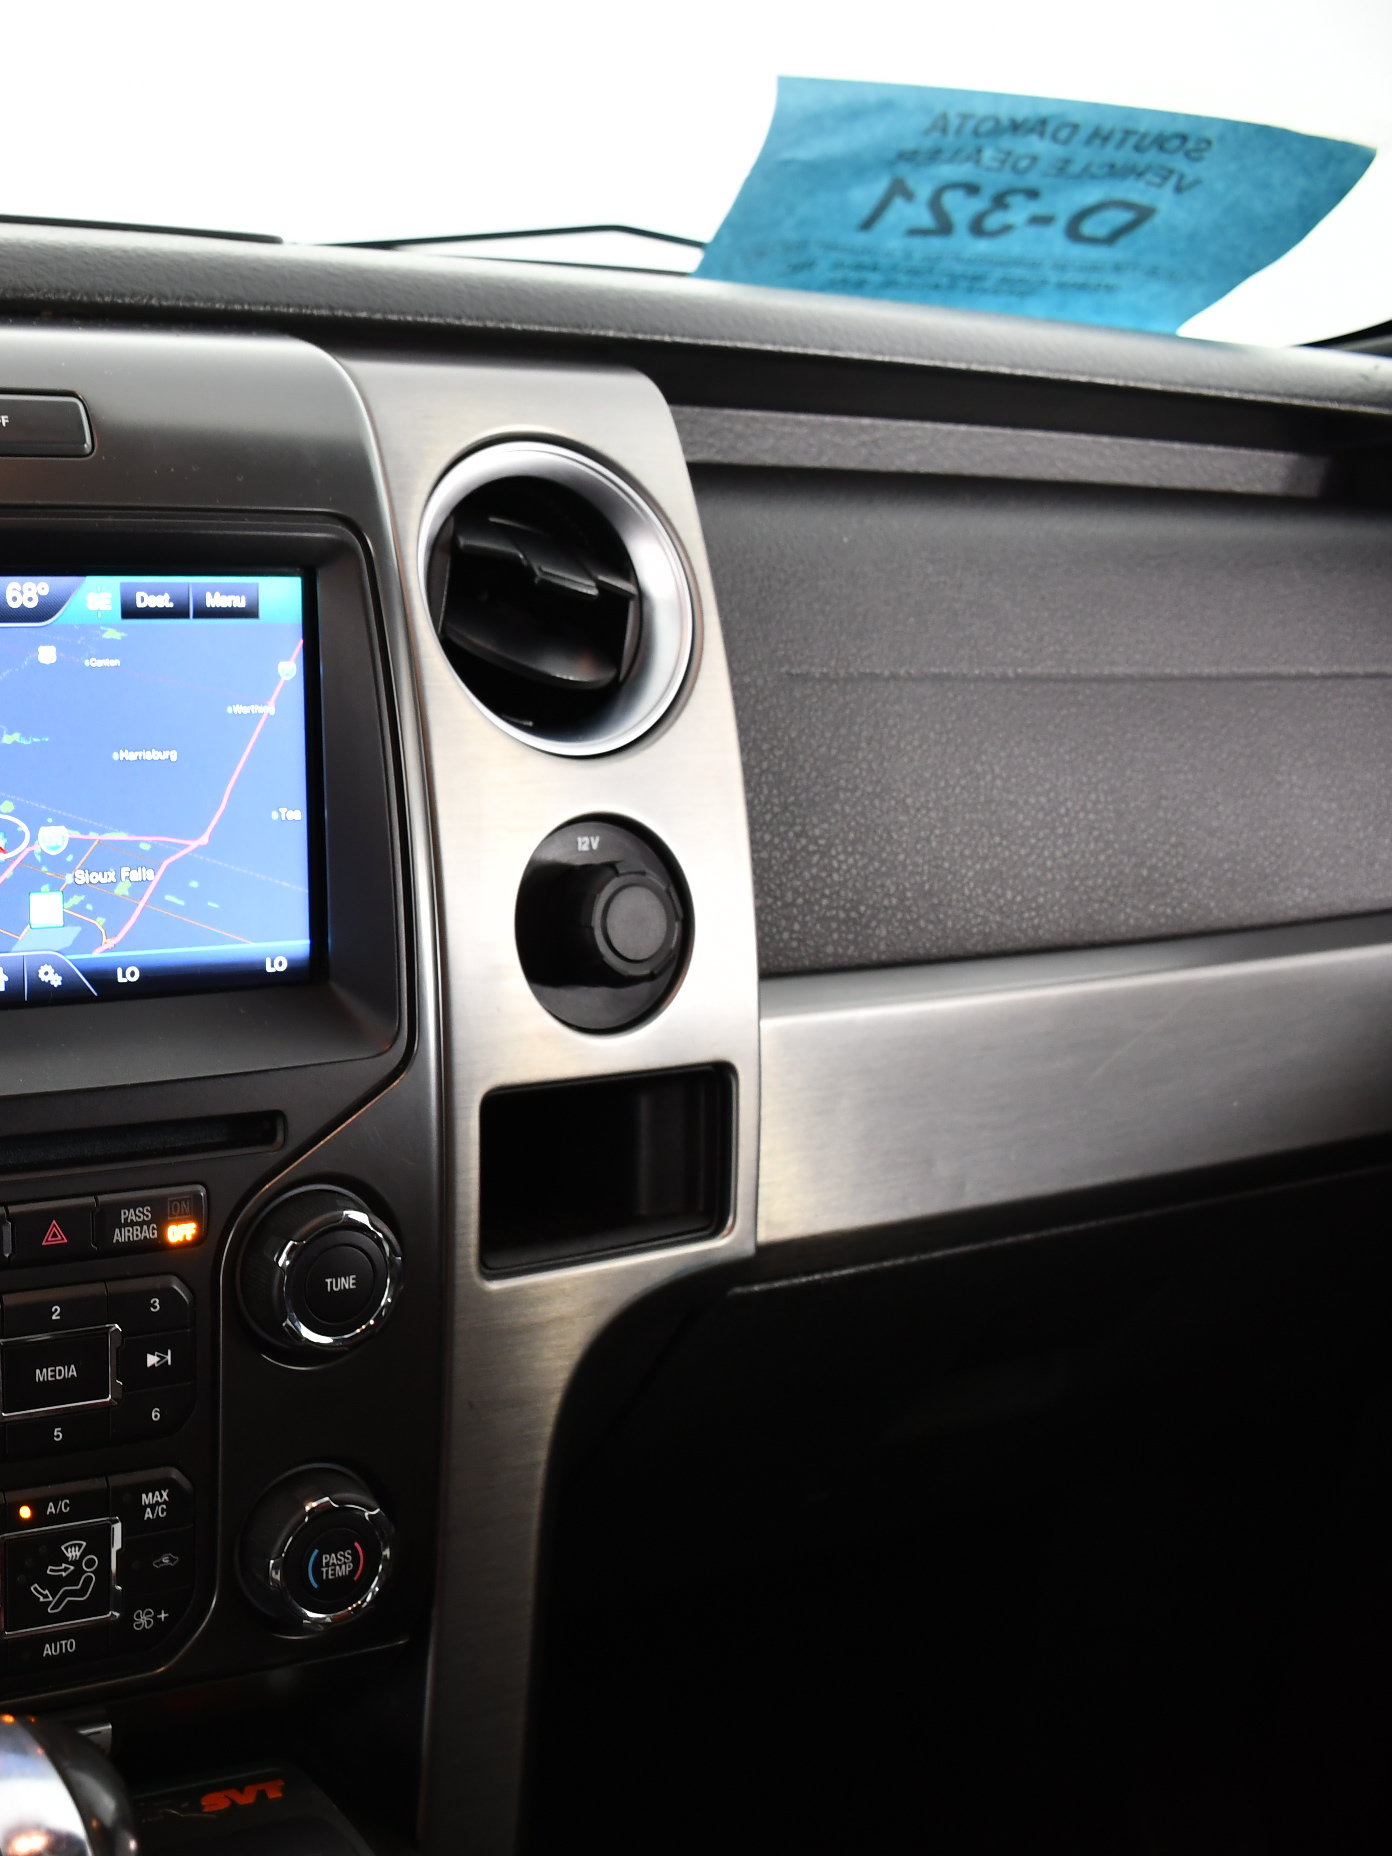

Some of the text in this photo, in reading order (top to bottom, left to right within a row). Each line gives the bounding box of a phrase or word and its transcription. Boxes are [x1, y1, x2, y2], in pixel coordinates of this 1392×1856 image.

[135, 591, 175, 608] Dest.
[205, 591, 246, 608] Menu
[119, 749, 178, 762] Harrisburg
[74, 866, 155, 885] Sioux Falls
[264, 956, 288, 973] LO
[116, 966, 140, 983] LO
[120, 1206, 152, 1224] PASS
[171, 1200, 190, 1216] ON
[112, 1223, 158, 1244] AIRBAG
[167, 1221, 197, 1243] OFF
[324, 1274, 357, 1293] TUNE
[51, 1304, 61, 1320] 2
[149, 1297, 160, 1312] 3
[35, 1363, 78, 1383] MEDIA
[151, 1407, 161, 1422] 6
[53, 1426, 63, 1442] 5
[141, 1488, 170, 1506] MAX
[46, 1498, 71, 1516] A/C
[143, 1504, 167, 1520] A/C
[322, 1549, 353, 1567] PASS
[320, 1562, 354, 1581] TEMP
[42, 1638, 76, 1657] AUTO
[199, 1778, 286, 1813] SVT
